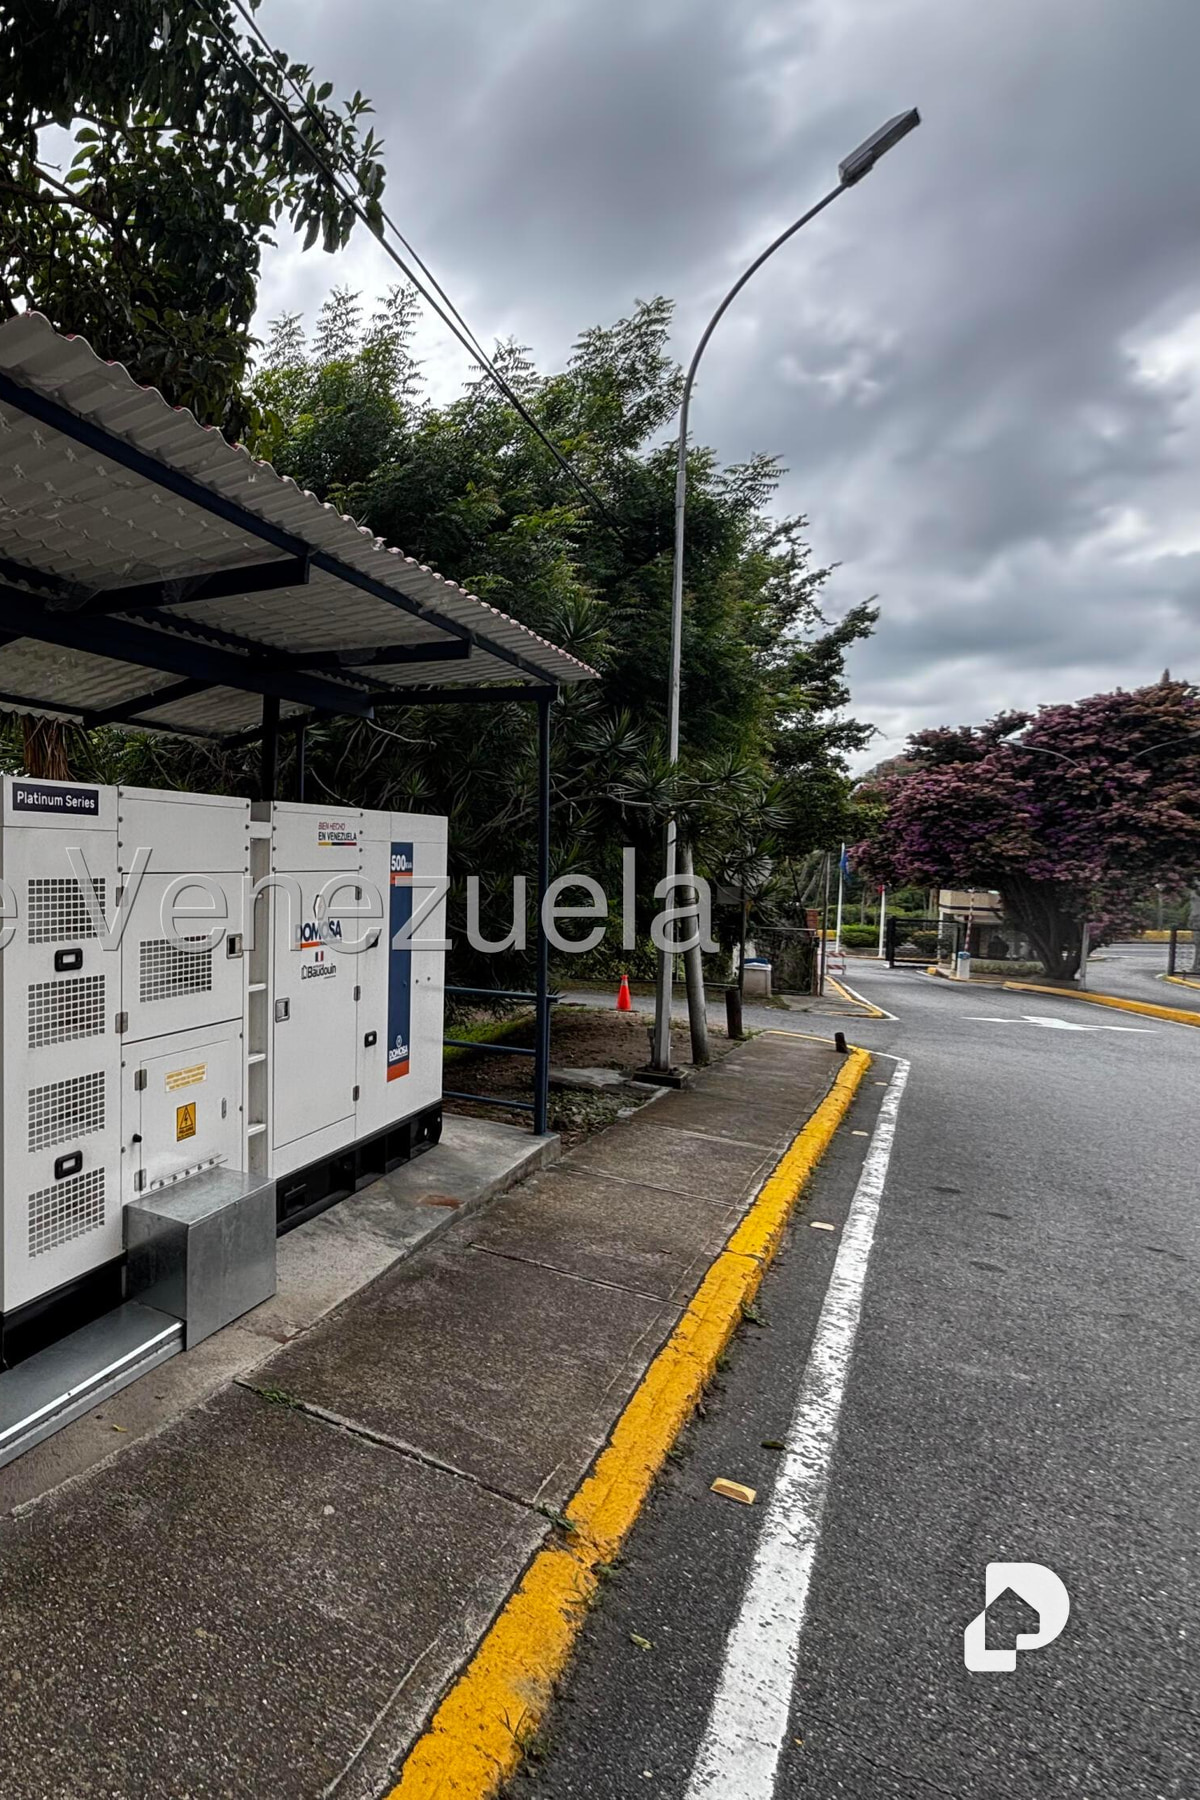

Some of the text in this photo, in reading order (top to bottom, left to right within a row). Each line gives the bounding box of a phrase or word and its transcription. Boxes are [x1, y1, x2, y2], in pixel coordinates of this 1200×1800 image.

[17, 791, 95, 808] Platinum Series
[318, 832, 357, 841] EN VENEZUELA
[295, 920, 342, 942] DOMOSA
[307, 963, 337, 978] Baudouin
